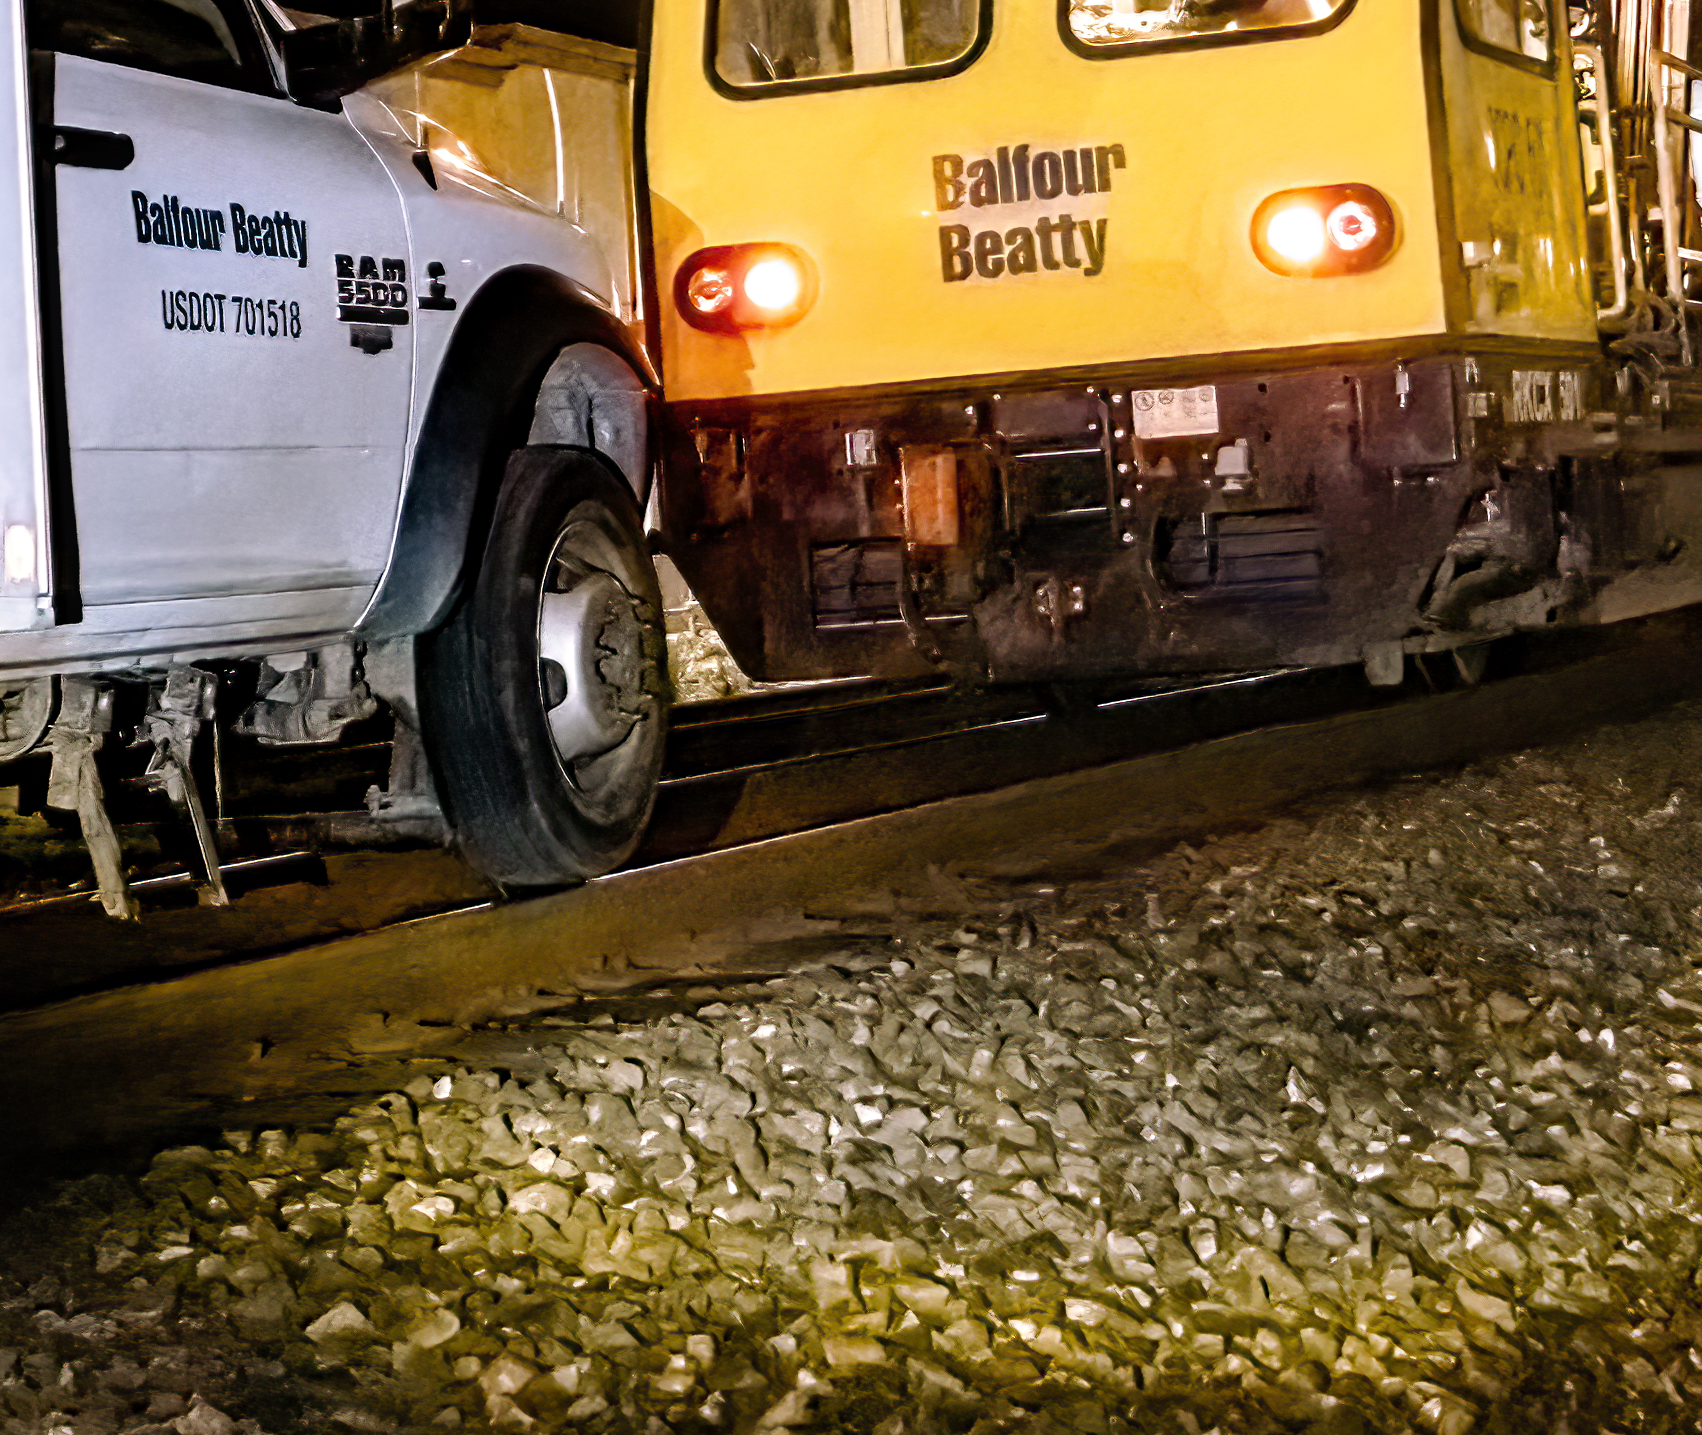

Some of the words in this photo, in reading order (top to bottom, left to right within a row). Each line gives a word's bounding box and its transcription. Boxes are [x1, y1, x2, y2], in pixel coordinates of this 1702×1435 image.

[931, 143, 1128, 212] Balfour
[130, 189, 226, 252] Balfour
[229, 201, 308, 268] Beatty
[938, 213, 1109, 283] Beatty
[335, 253, 406, 283] RAM
[337, 279, 408, 308] 5500
[161, 289, 226, 333] USDOT
[230, 295, 303, 340] 701518
